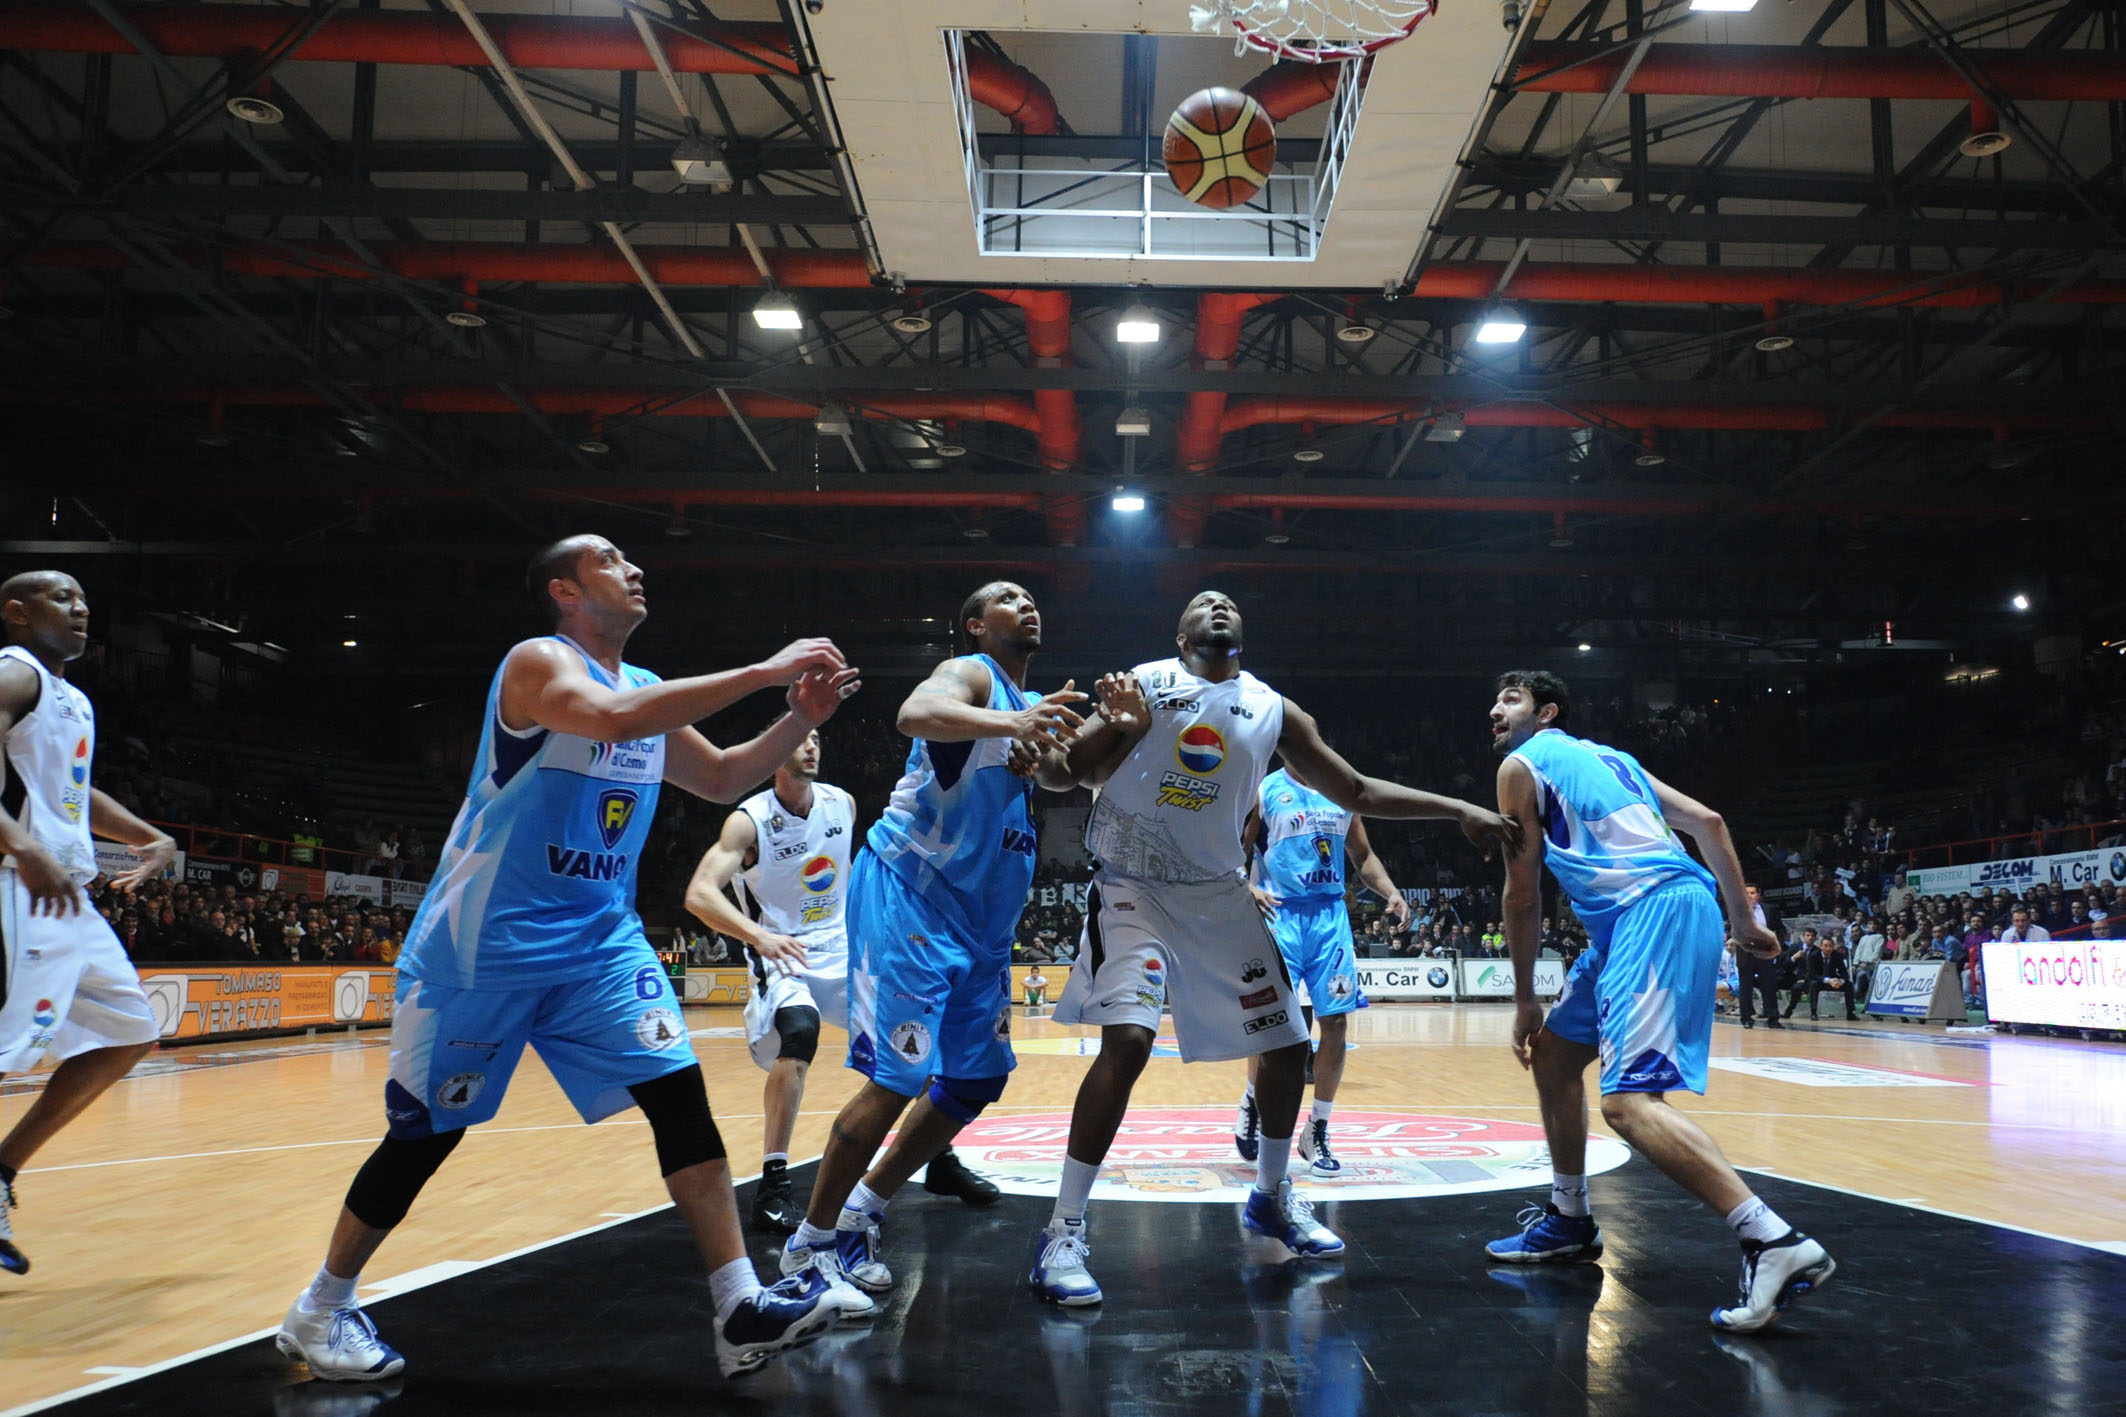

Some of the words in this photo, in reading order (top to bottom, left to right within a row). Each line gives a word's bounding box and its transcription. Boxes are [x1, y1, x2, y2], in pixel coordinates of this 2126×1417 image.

[1160, 771, 1221, 798] PEPSI
[1156, 786, 1213, 811] Twist
[775, 842, 808, 860] ELDO
[2073, 862, 2099, 882] Car
[216, 971, 281, 994] TOMMASO
[634, 967, 664, 1000] 6
[1357, 972, 1379, 986] M.
[1386, 972, 1419, 986] Car
[199, 997, 281, 1035] VERAZZO
[1244, 1012, 1288, 1034] ELDO
